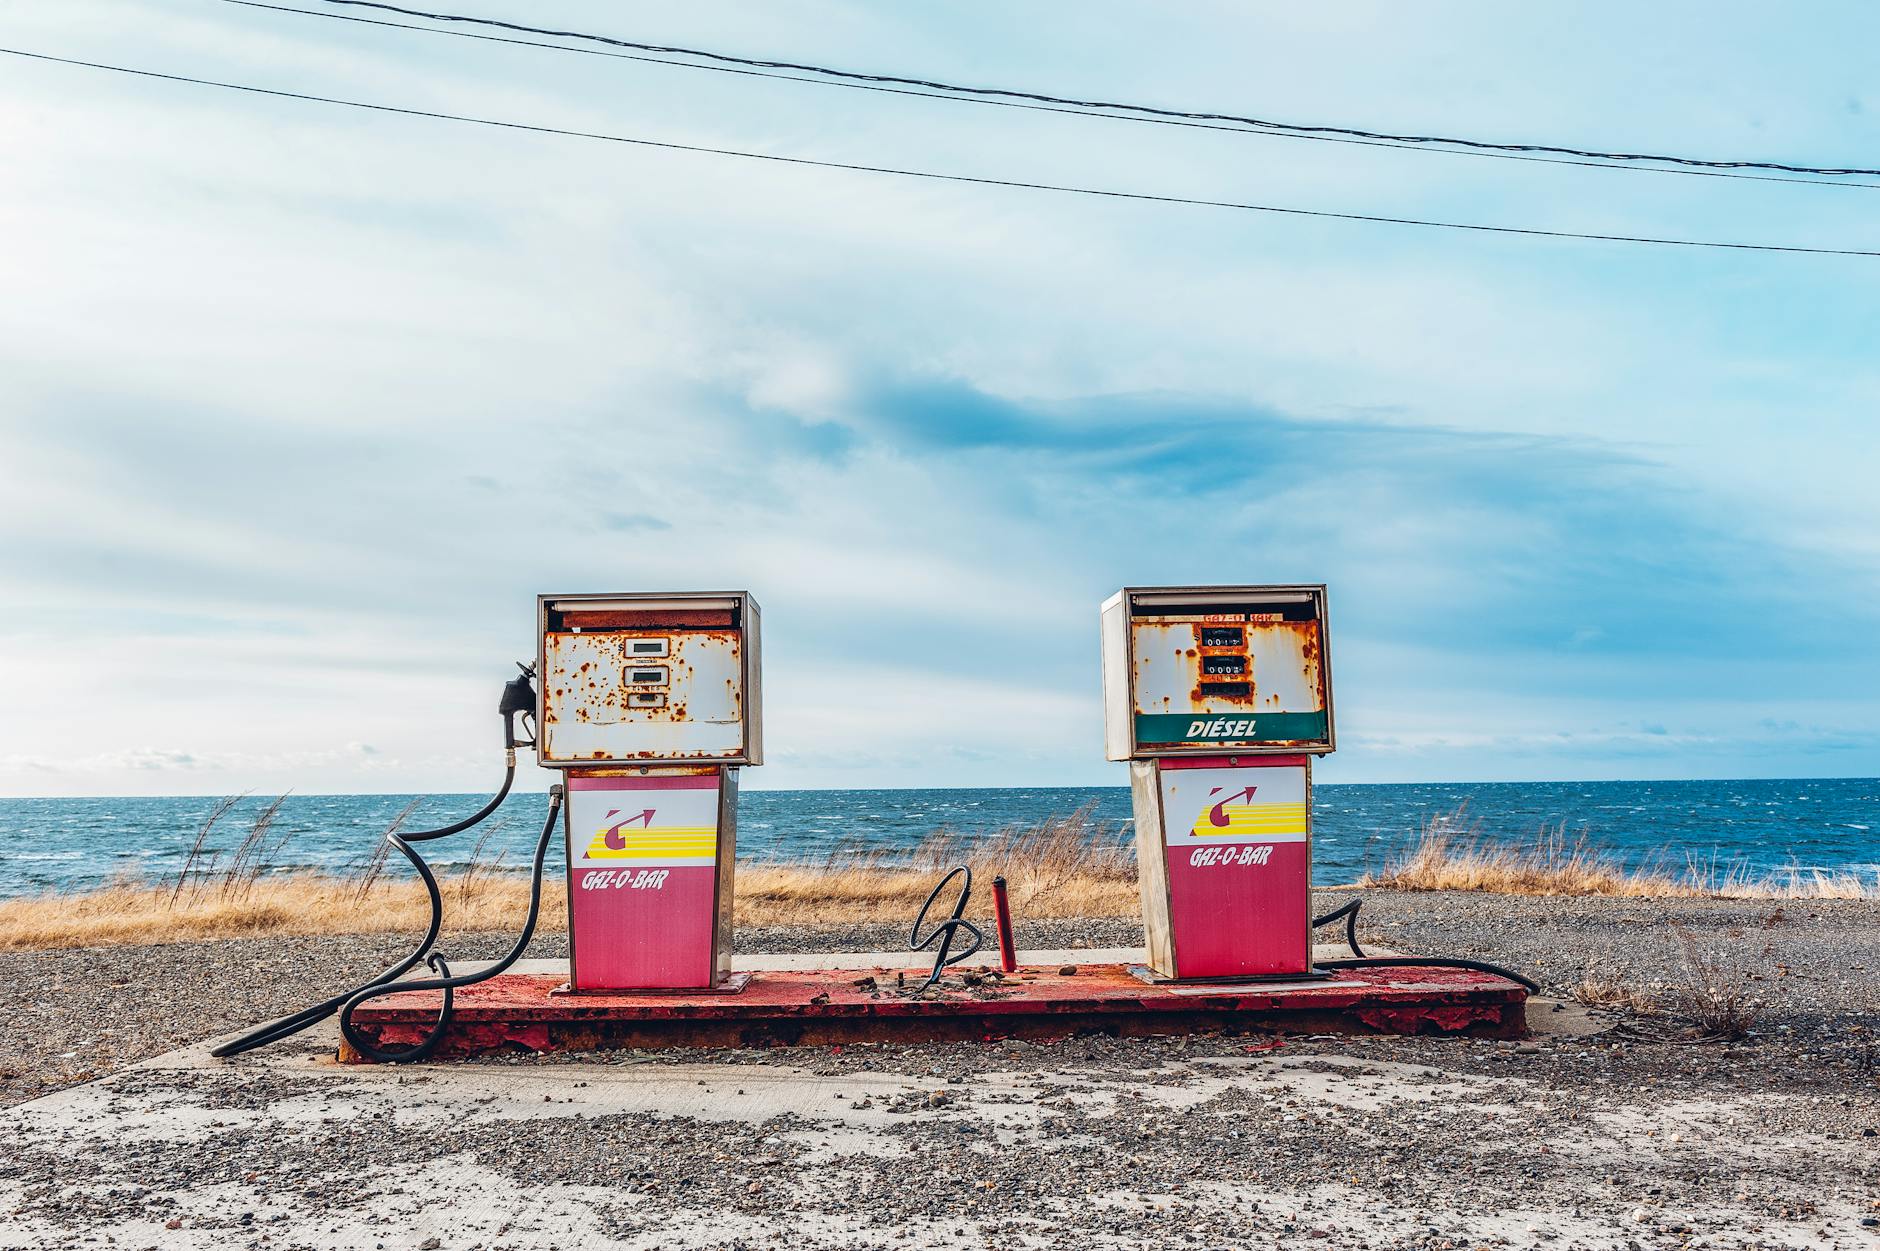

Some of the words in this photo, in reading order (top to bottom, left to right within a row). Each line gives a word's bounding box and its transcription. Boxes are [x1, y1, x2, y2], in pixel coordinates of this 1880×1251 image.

[1186, 717, 1257, 738] DIÉSEL
[1189, 845, 1274, 868] GAZ-O-BAR
[581, 870, 670, 891] GAZ-O-BAR
